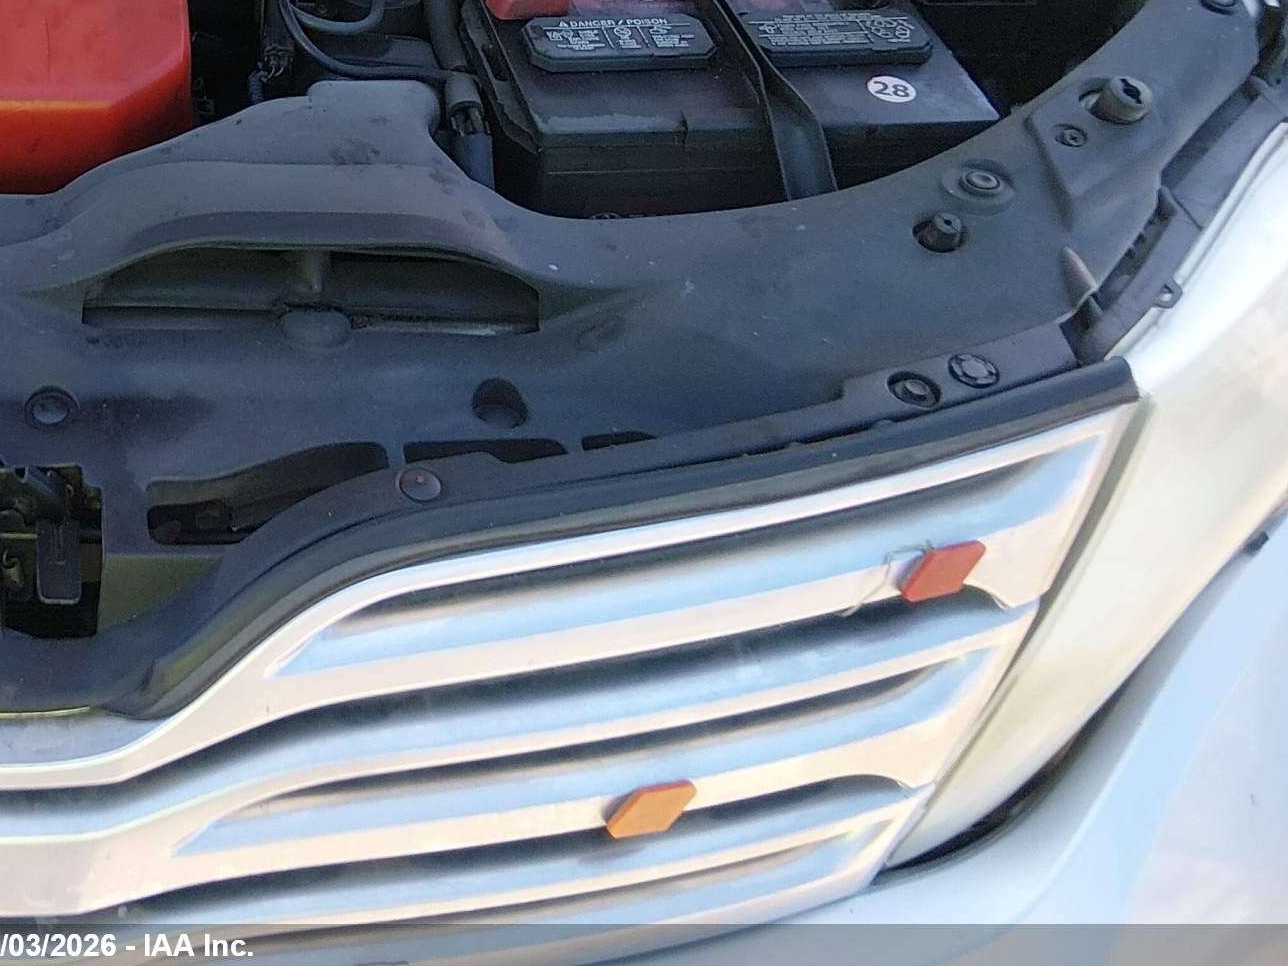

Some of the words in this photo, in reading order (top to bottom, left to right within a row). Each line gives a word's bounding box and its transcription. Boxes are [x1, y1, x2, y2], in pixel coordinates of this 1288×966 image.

[569, 18, 615, 28] DANGER
[626, 17, 668, 26] POISON
[873, 80, 910, 98] 28
